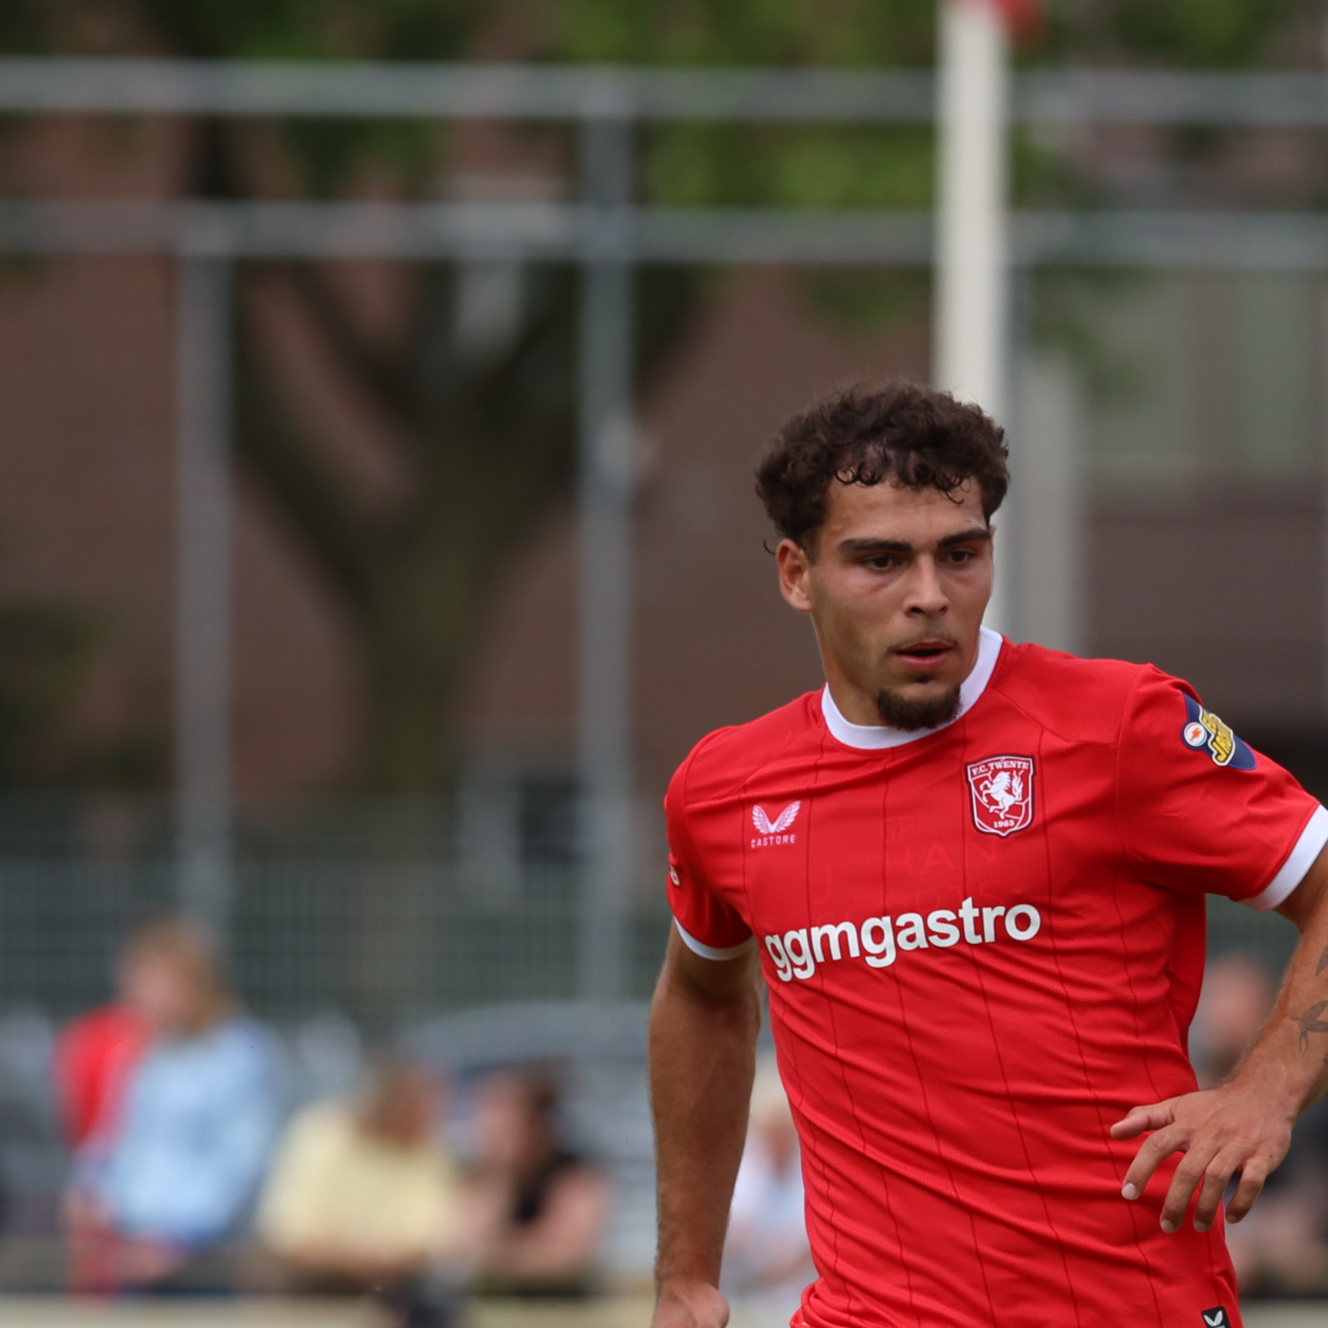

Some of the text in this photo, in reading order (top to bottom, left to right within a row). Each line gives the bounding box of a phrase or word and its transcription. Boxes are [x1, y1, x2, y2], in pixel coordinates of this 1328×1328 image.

[988, 760, 1030, 771] TWENTE
[993, 820, 1016, 829] 1965
[750, 833, 797, 849] CASTORE
[764, 896, 1042, 982] ggmgastro
